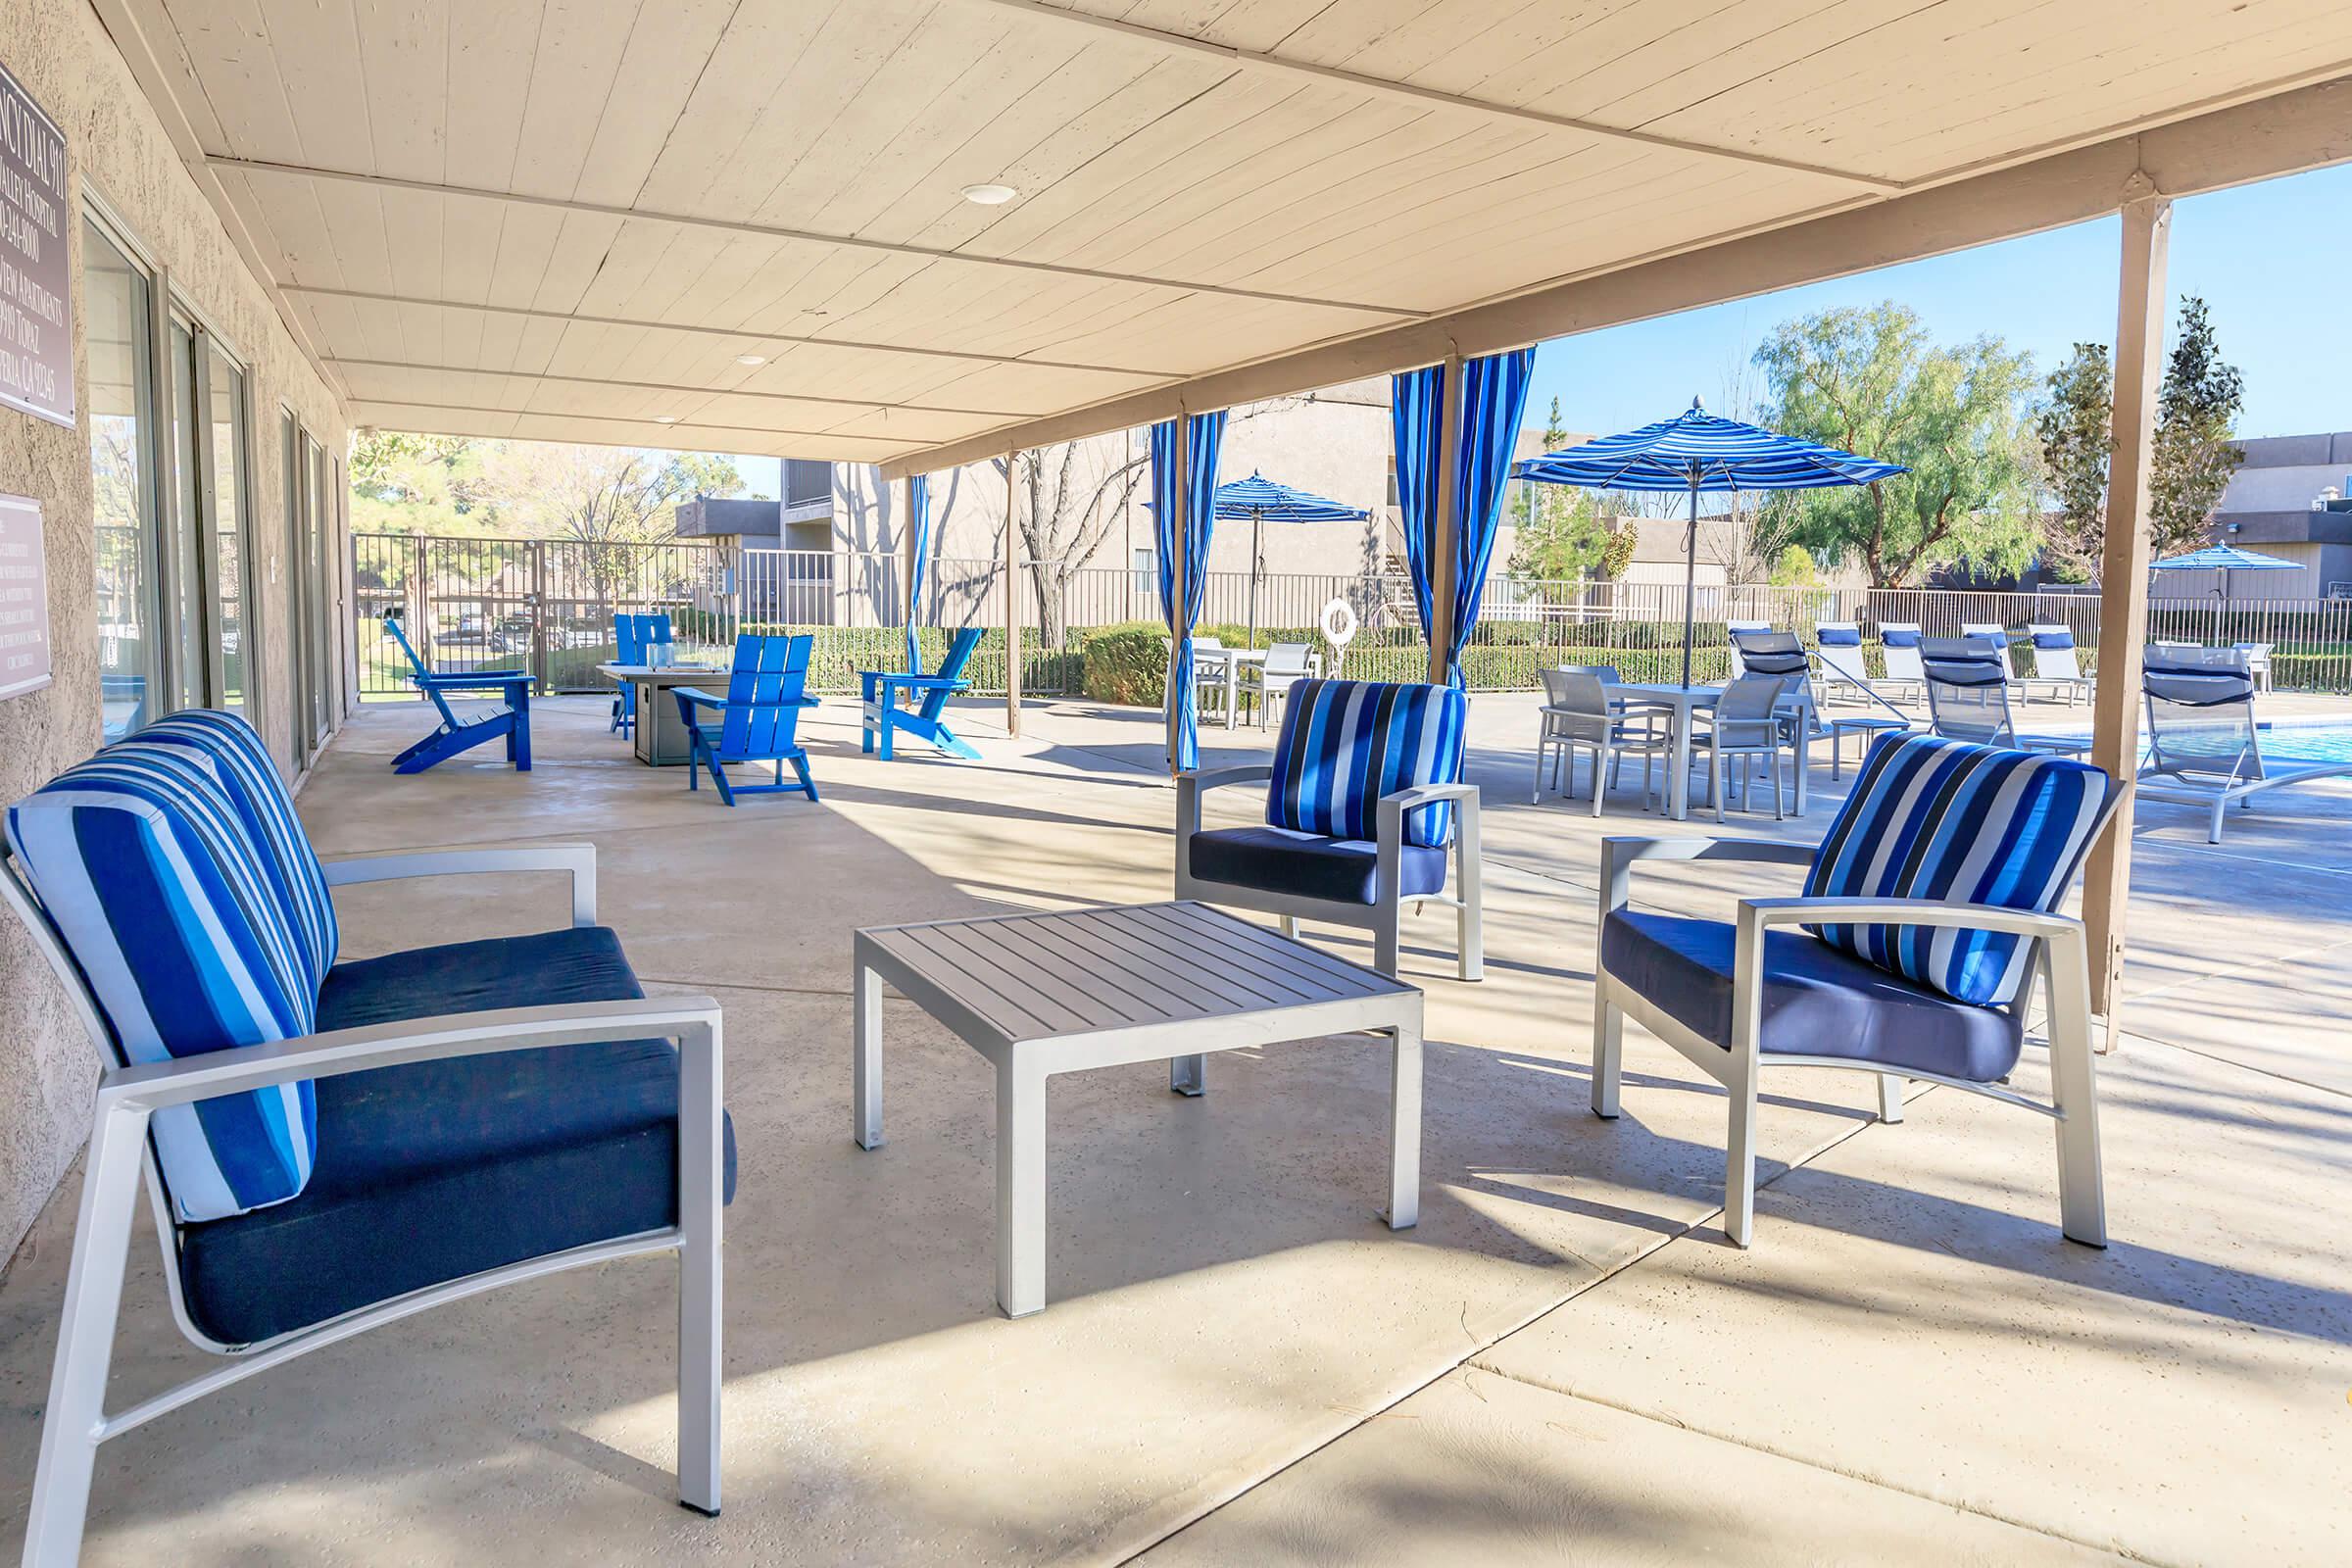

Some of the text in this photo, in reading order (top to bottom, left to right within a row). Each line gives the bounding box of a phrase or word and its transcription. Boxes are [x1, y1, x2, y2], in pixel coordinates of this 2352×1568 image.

[24, 109, 49, 186] DIAL
[50, 138, 64, 201] 911
[24, 178, 58, 238] HOSPITAL
[19, 268, 63, 327] APARTMENTS
[16, 308, 39, 355] TOPAZ
[23, 356, 34, 394] CA
[34, 361, 55, 402] 92345
